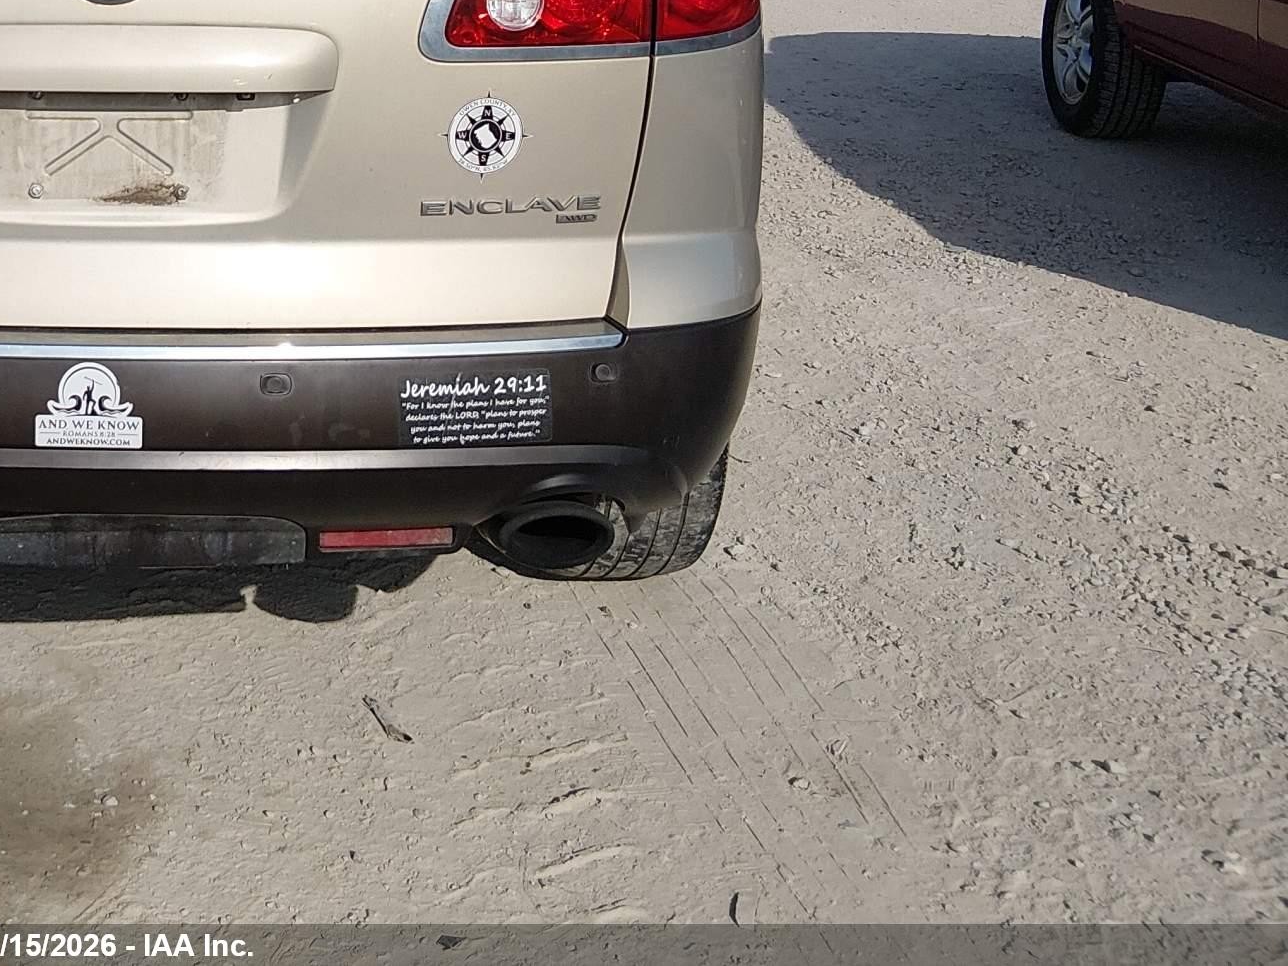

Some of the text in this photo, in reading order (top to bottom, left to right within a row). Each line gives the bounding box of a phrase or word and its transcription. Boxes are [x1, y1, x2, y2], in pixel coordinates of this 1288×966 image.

[484, 109, 491, 117] N
[457, 131, 467, 139] W
[420, 196, 601, 216] ENCLAVE
[400, 375, 547, 398] Jeremiah 29:11
[426, 401, 449, 409] know
[465, 399, 489, 410] plans
[495, 398, 515, 406] have
[516, 396, 528, 406] for
[406, 413, 440, 421] declares
[440, 412, 454, 420] the
[509, 409, 518, 417] to
[519, 409, 547, 417] prosper
[39, 419, 139, 431] AND WE KNOW
[411, 426, 427, 434] you
[428, 423, 446, 431] and
[447, 423, 462, 431] not
[463, 423, 472, 431] to
[517, 419, 541, 429] plans
[46, 437, 130, 446] ANDWEKNOW.COM
[413, 436, 423, 444] to
[423, 435, 441, 444] give
[442, 436, 458, 444] you
[481, 431, 499, 440] and
